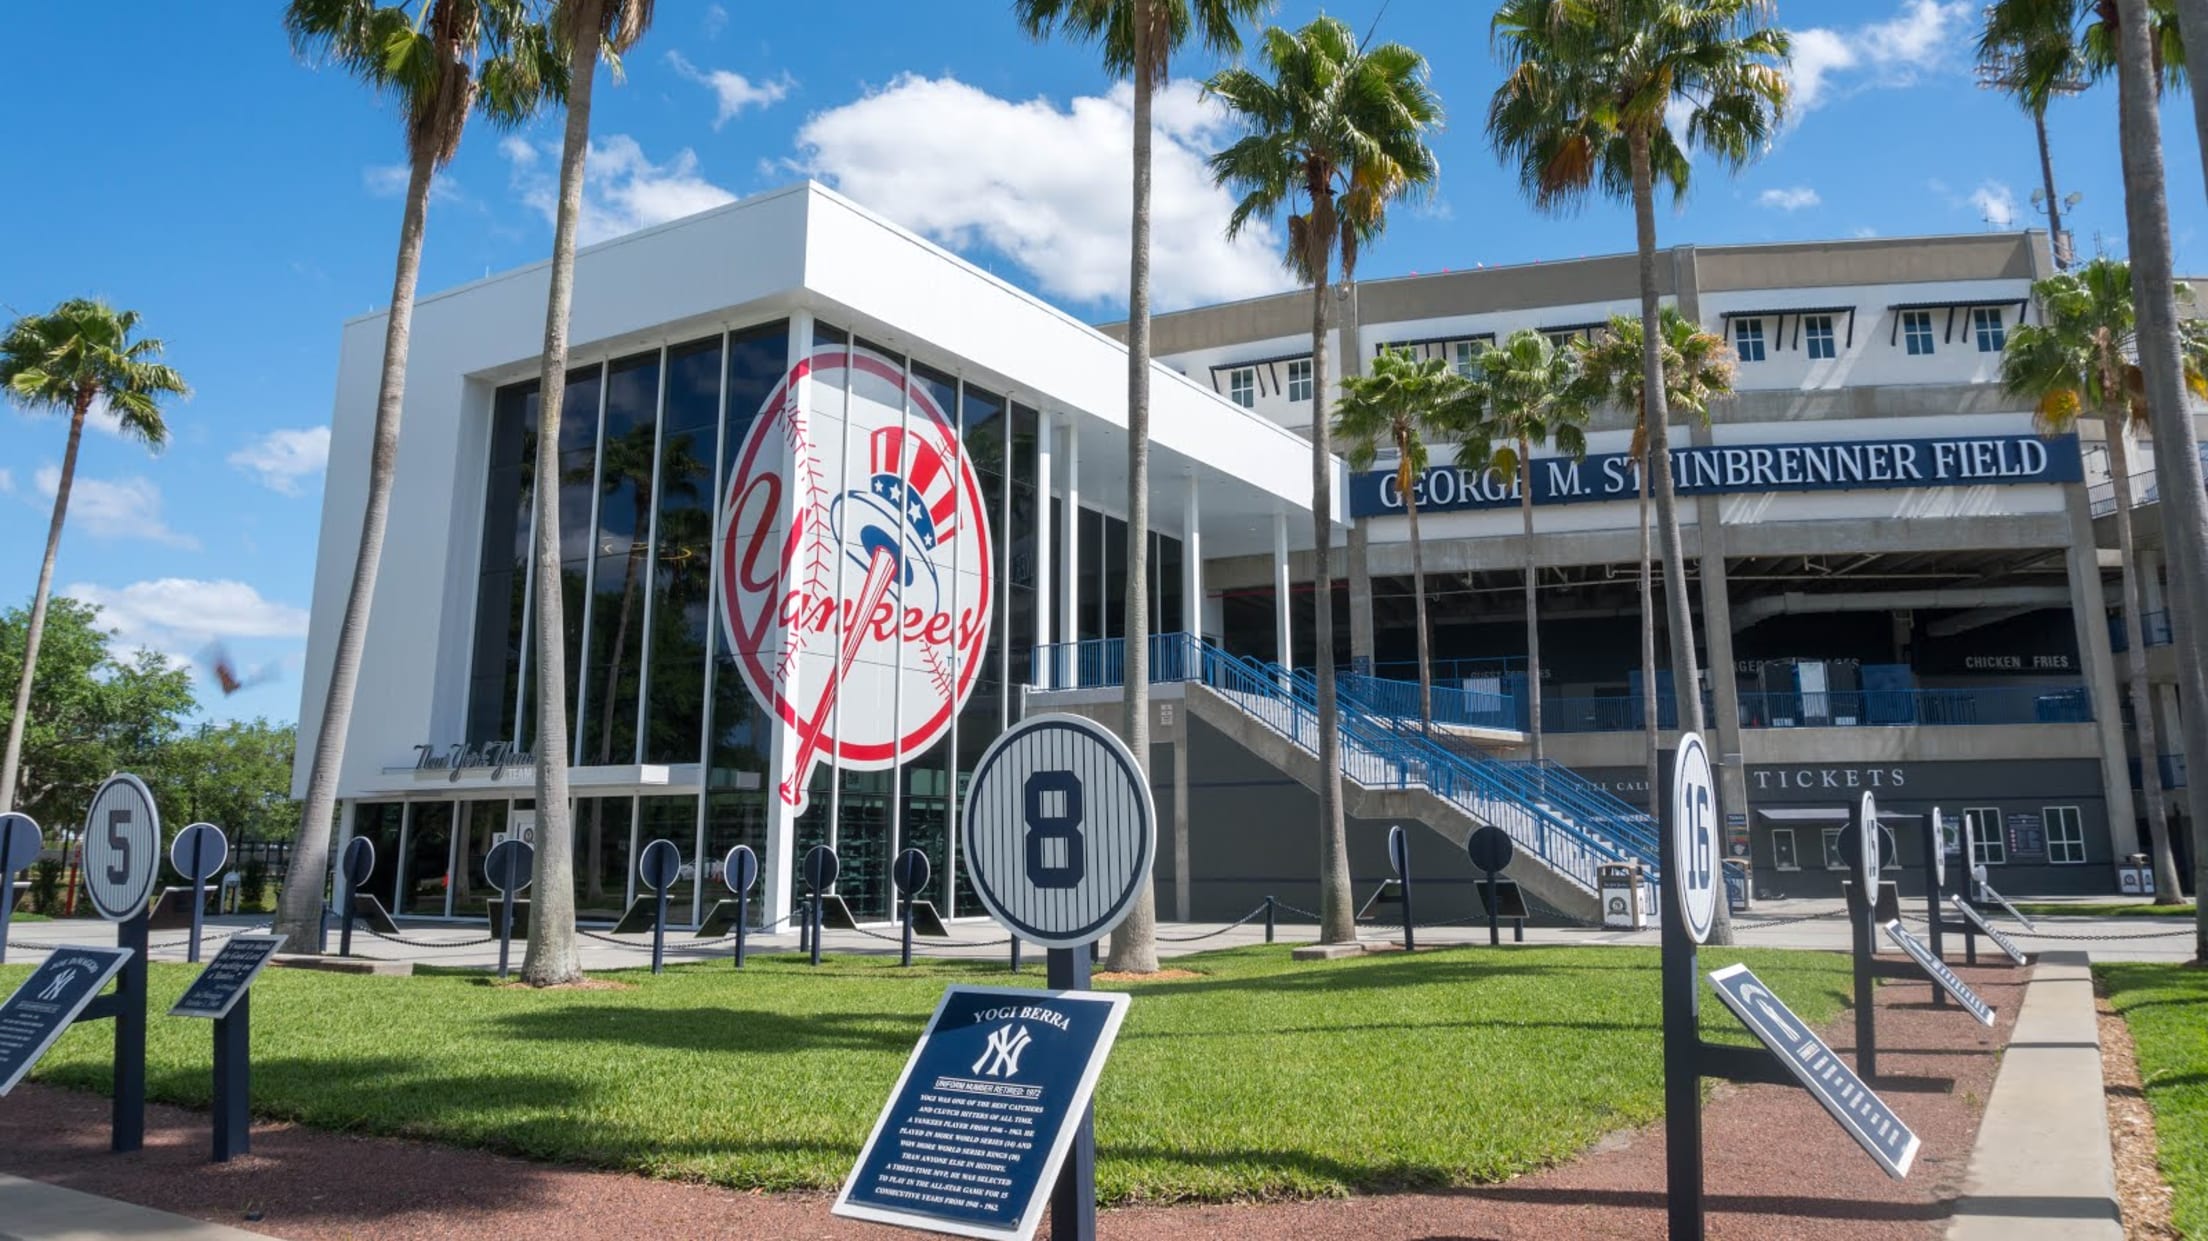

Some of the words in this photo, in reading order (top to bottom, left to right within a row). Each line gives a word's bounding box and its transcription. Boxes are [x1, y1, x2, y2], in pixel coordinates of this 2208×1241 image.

[1547, 462, 1591, 497] M.
[1603, 443, 1922, 492] STINBRENNER
[1932, 439, 2047, 478] FIELD
[1965, 655, 2021, 669] CHICKEN
[2033, 655, 2069, 668] FRIES
[413, 743, 450, 770] New
[508, 767, 534, 780] TEAM
[1753, 768, 1905, 789] TICKETS
[1025, 770, 1084, 889] 8
[1686, 782, 1710, 890] 16
[107, 810, 131, 885] 5
[973, 1006, 1018, 1024] YOGI
[1019, 1006, 1070, 1031] BERRA
